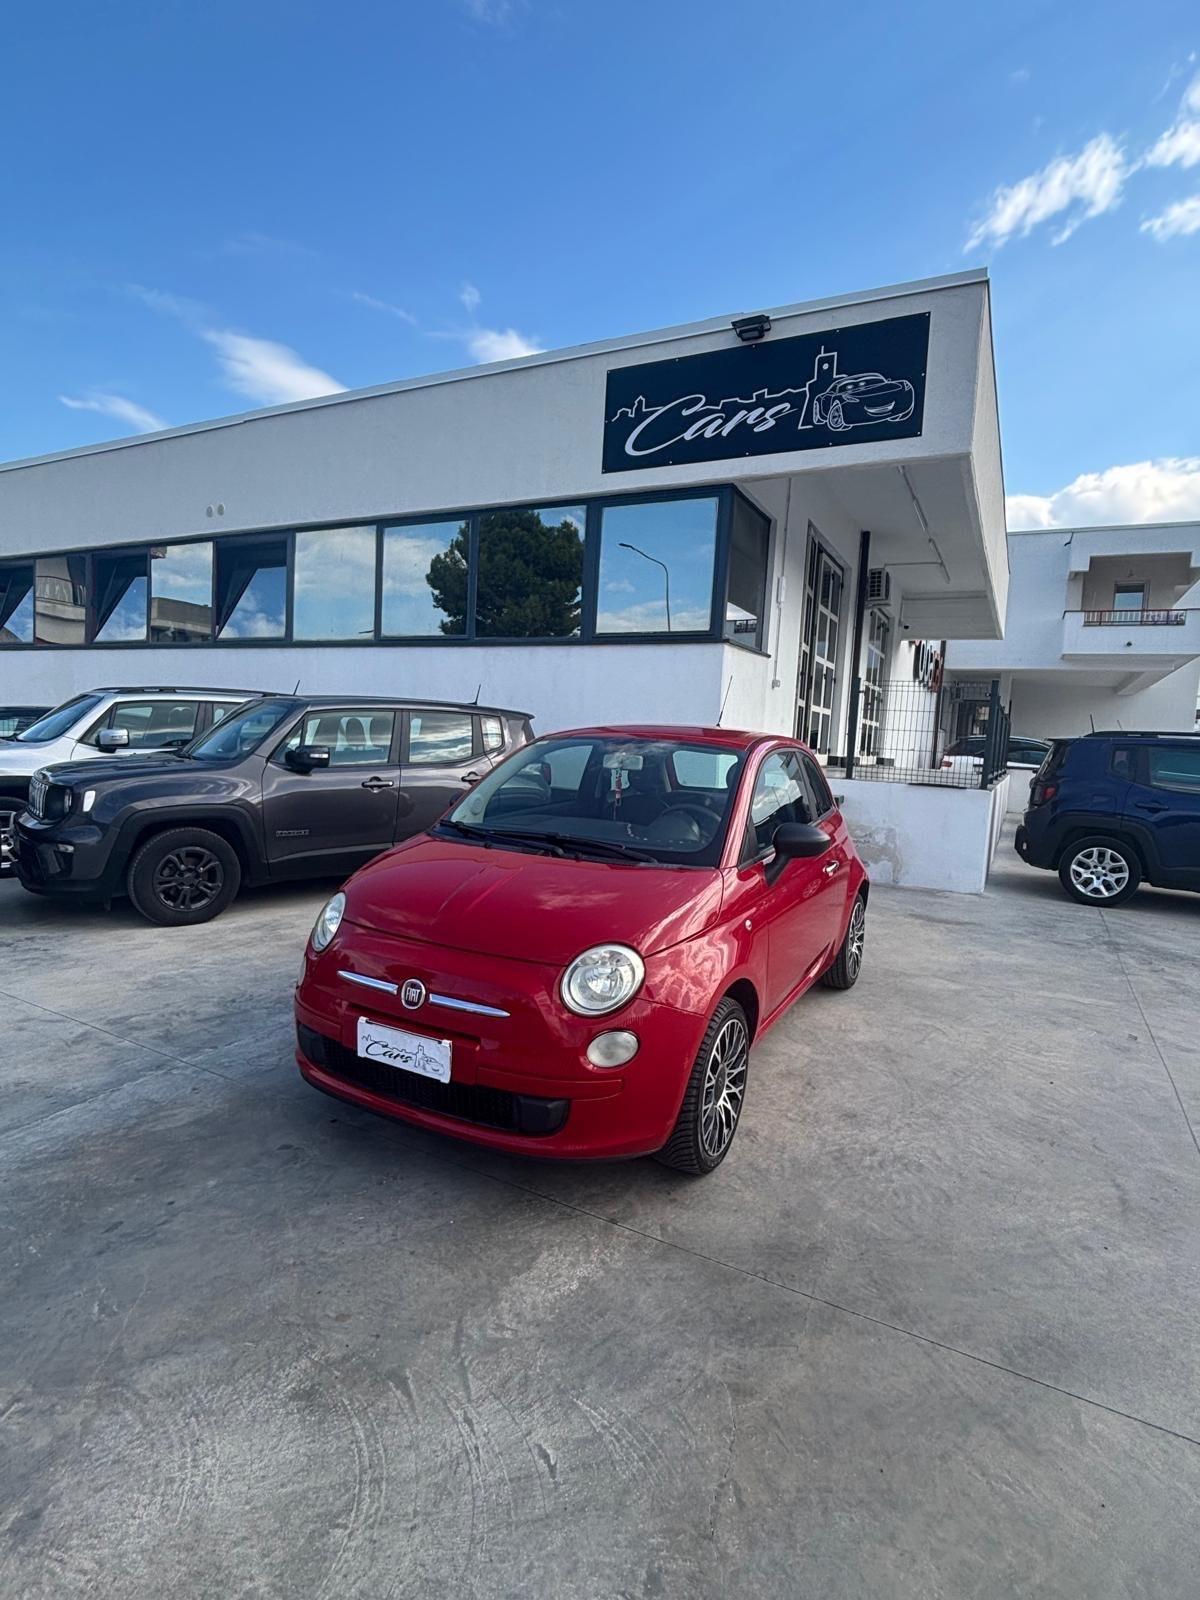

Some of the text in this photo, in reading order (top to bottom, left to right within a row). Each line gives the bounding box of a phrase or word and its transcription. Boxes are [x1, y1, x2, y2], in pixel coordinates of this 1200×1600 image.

[624, 395, 798, 456] Cars
[405, 987, 421, 1003] FIAT
[366, 1041, 413, 1063] Cars
